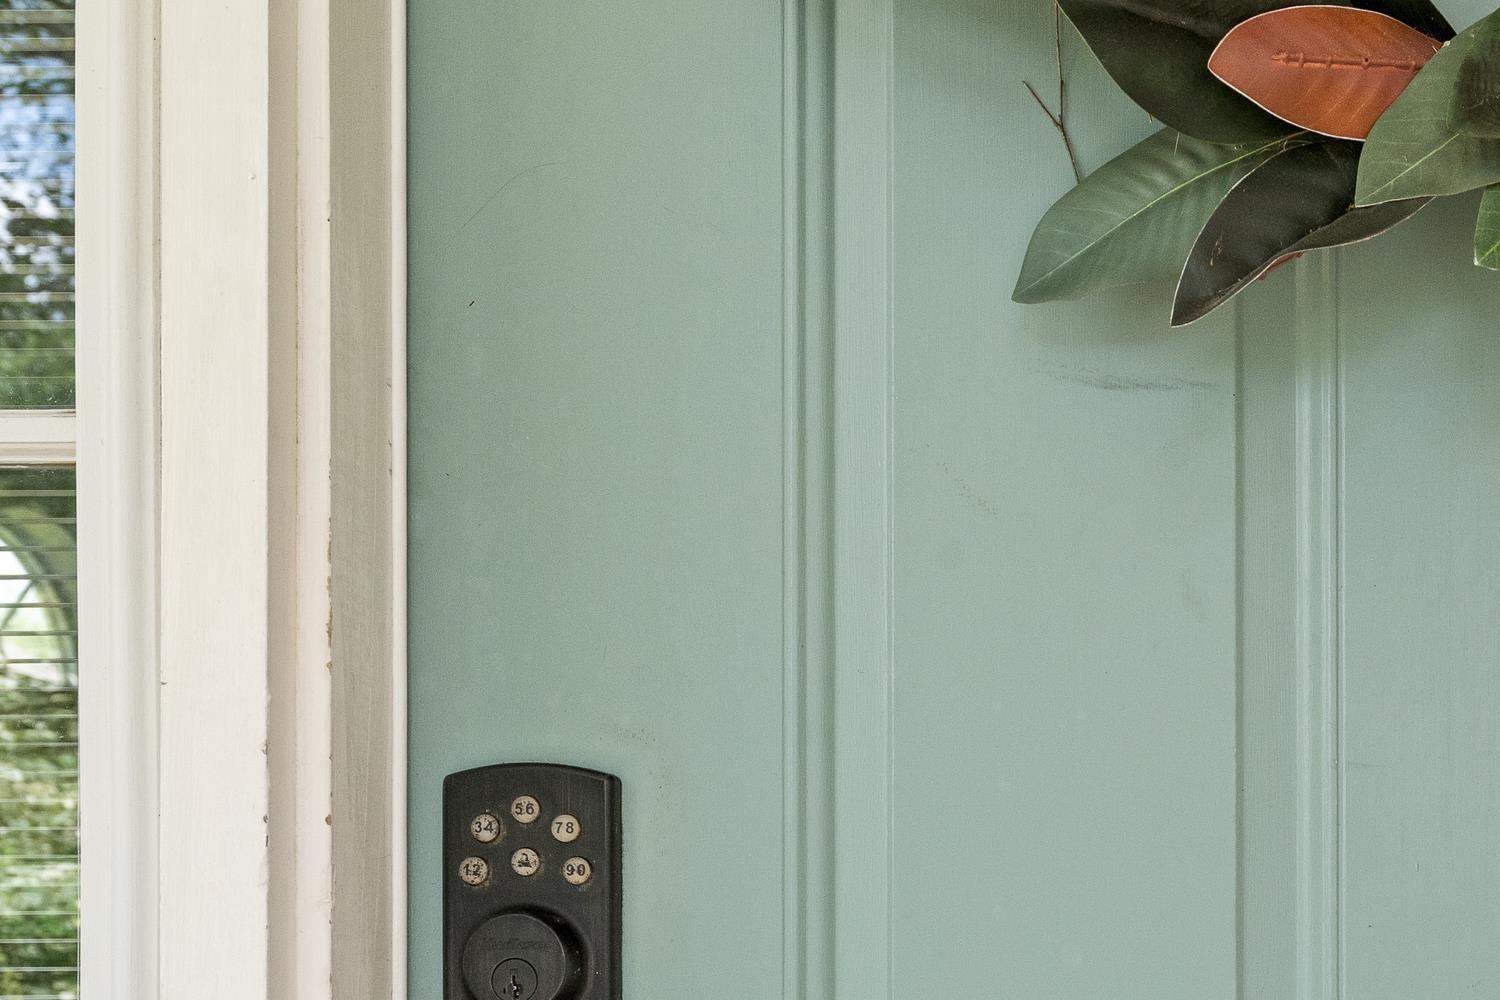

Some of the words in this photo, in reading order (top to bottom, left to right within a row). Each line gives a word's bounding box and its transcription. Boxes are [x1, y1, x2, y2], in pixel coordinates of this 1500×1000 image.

[515, 802, 534, 815] 56
[474, 821, 494, 833] 34
[555, 821, 574, 834] 78
[566, 863, 586, 876] 90
